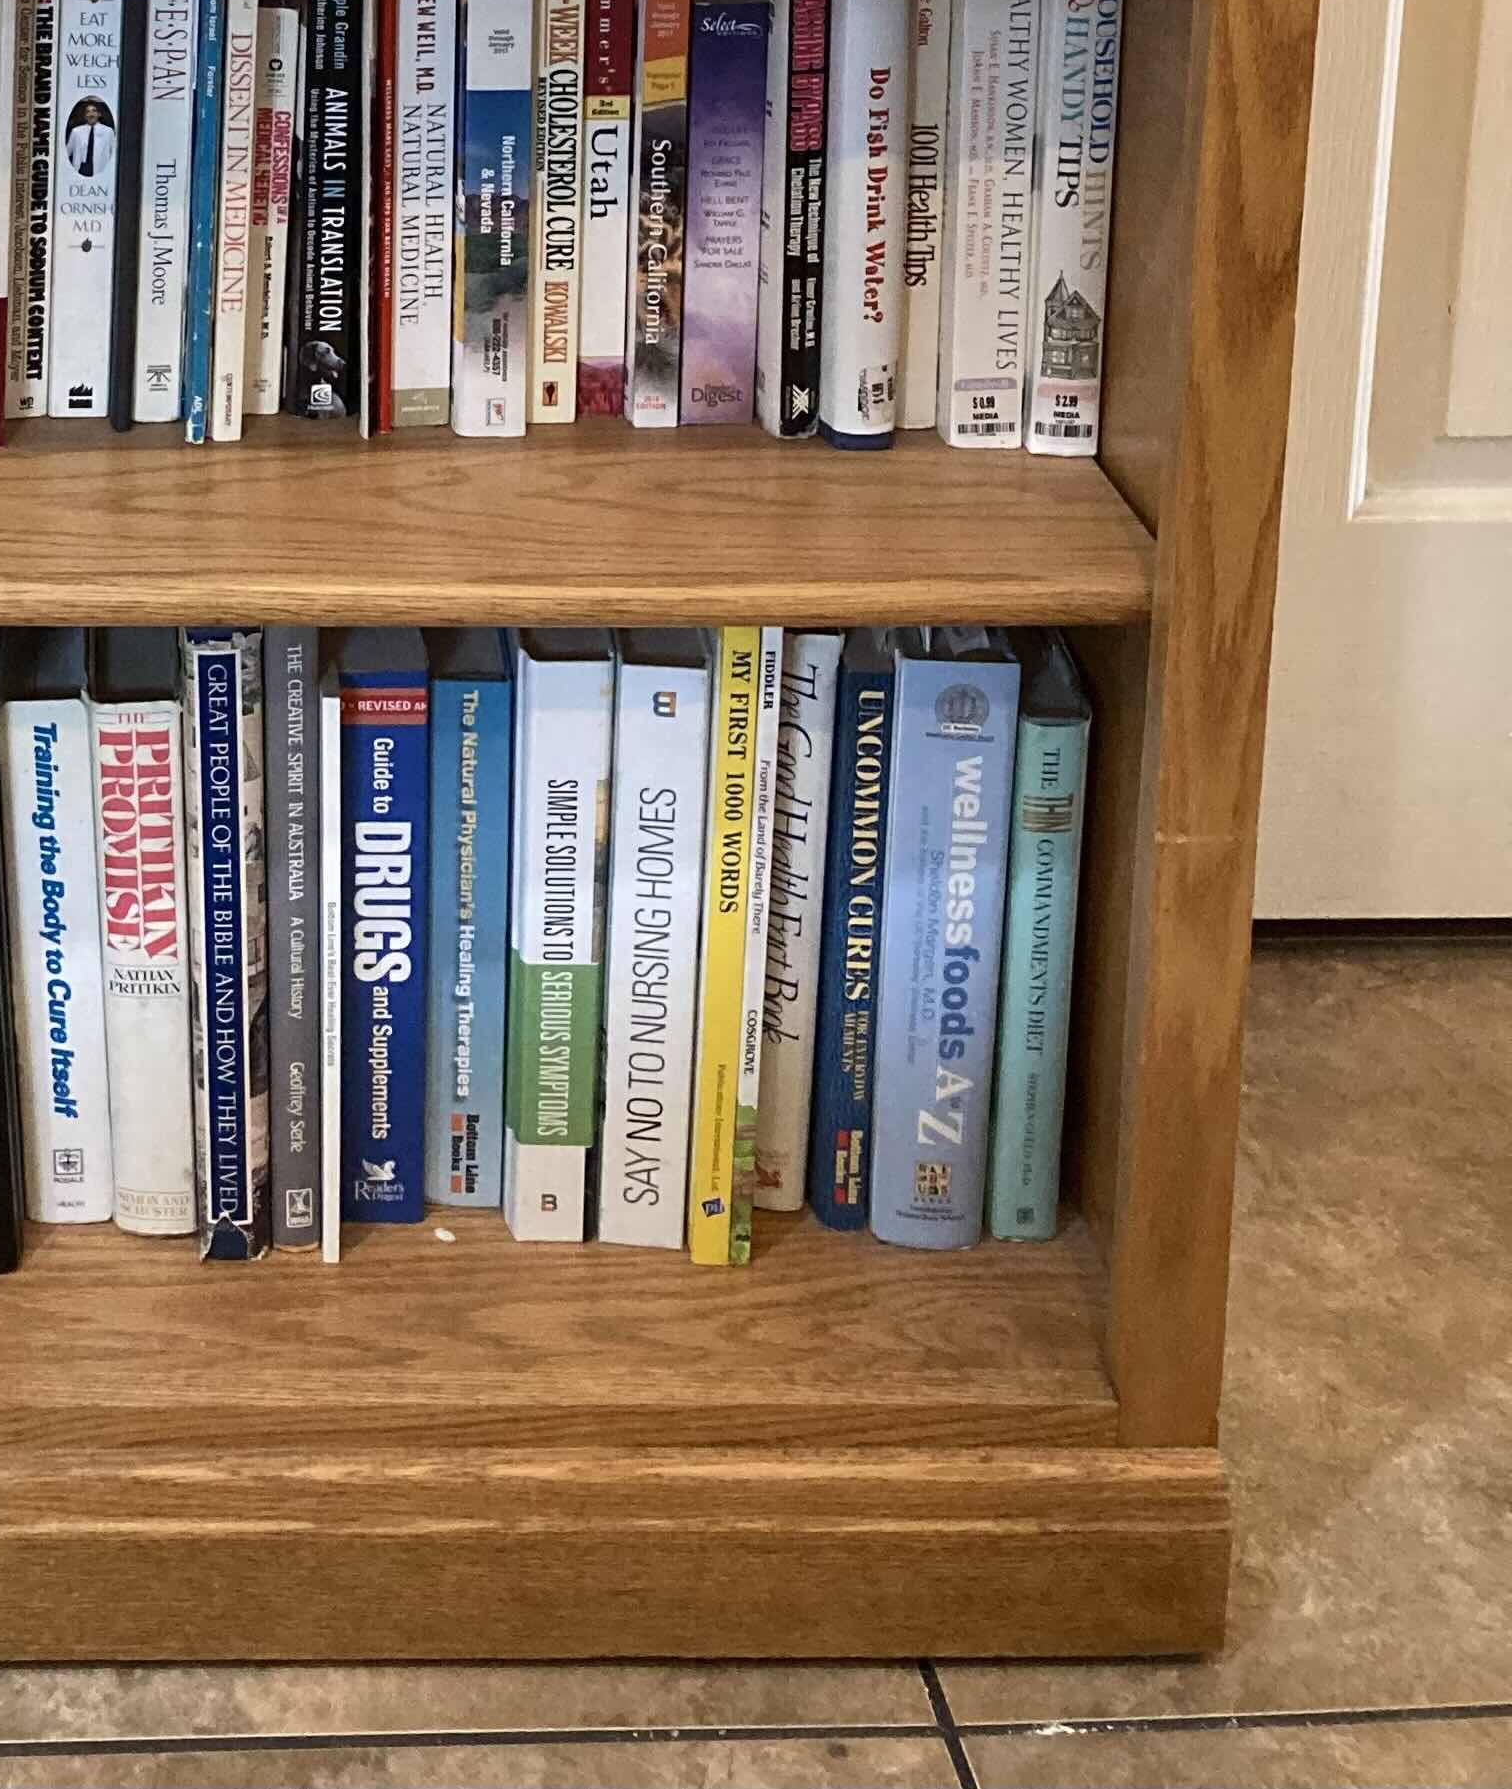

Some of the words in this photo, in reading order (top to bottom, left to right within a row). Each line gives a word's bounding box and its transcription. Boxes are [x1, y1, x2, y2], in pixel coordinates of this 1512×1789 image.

[868, 68, 889, 99] Do
[1059, 17, 1090, 127] HANDY
[323, 88, 350, 171] ANIMALS
[546, 69, 579, 212] CHOLESTEROL
[866, 109, 888, 157] Fish
[589, 125, 619, 220] Utah
[647, 139, 672, 238] Southern
[864, 167, 887, 232] Drink
[1055, 135, 1083, 207] TIPS
[318, 206, 346, 332] TRANSLATION
[545, 216, 576, 270] CURE
[644, 238, 667, 345] California
[691, 388, 743, 407] Digest
[731, 651, 753, 682] MY
[762, 650, 776, 710] FIDDLER
[206, 664, 229, 734] GREAT
[358, 700, 411, 712] REVISED
[727, 693, 750, 759] FIRST
[31, 723, 63, 830] Training
[208, 743, 231, 818] PEOPLE
[373, 738, 394, 790] Guide
[850, 691, 887, 885] UNCOMMON
[373, 796, 393, 814] to
[546, 780, 579, 839] SIMPLE
[723, 773, 746, 821] 1000
[37, 836, 65, 875] the
[210, 824, 231, 852] OF
[635, 788, 678, 899] HOMES
[211, 859, 232, 902] THE
[353, 821, 412, 983] DRUGS
[543, 845, 577, 936] SOLUTIONS
[719, 832, 743, 912] WORDS
[39, 879, 69, 944] Body
[212, 910, 234, 965] BIBLE
[43, 949, 71, 974] to
[542, 943, 574, 960] TO
[629, 908, 673, 1043] NURSING
[845, 895, 876, 1000] CURES
[45, 979, 75, 1043] Cure
[214, 972, 235, 1023] AND
[373, 986, 393, 1015] and
[539, 971, 574, 1041] SERIOUS
[215, 1029, 236, 1083] HOW
[628, 1052, 666, 1085] TO
[743, 1010, 758, 1075] COSGROVE
[48, 1048, 79, 1118] Itself
[372, 1025, 392, 1139] Supplements
[537, 1045, 571, 1136] SYMPTOMS
[216, 1092, 237, 1145] THEY
[625, 1097, 664, 1141] NO
[218, 1156, 239, 1216] LIVED
[623, 1148, 662, 1205] SAY
